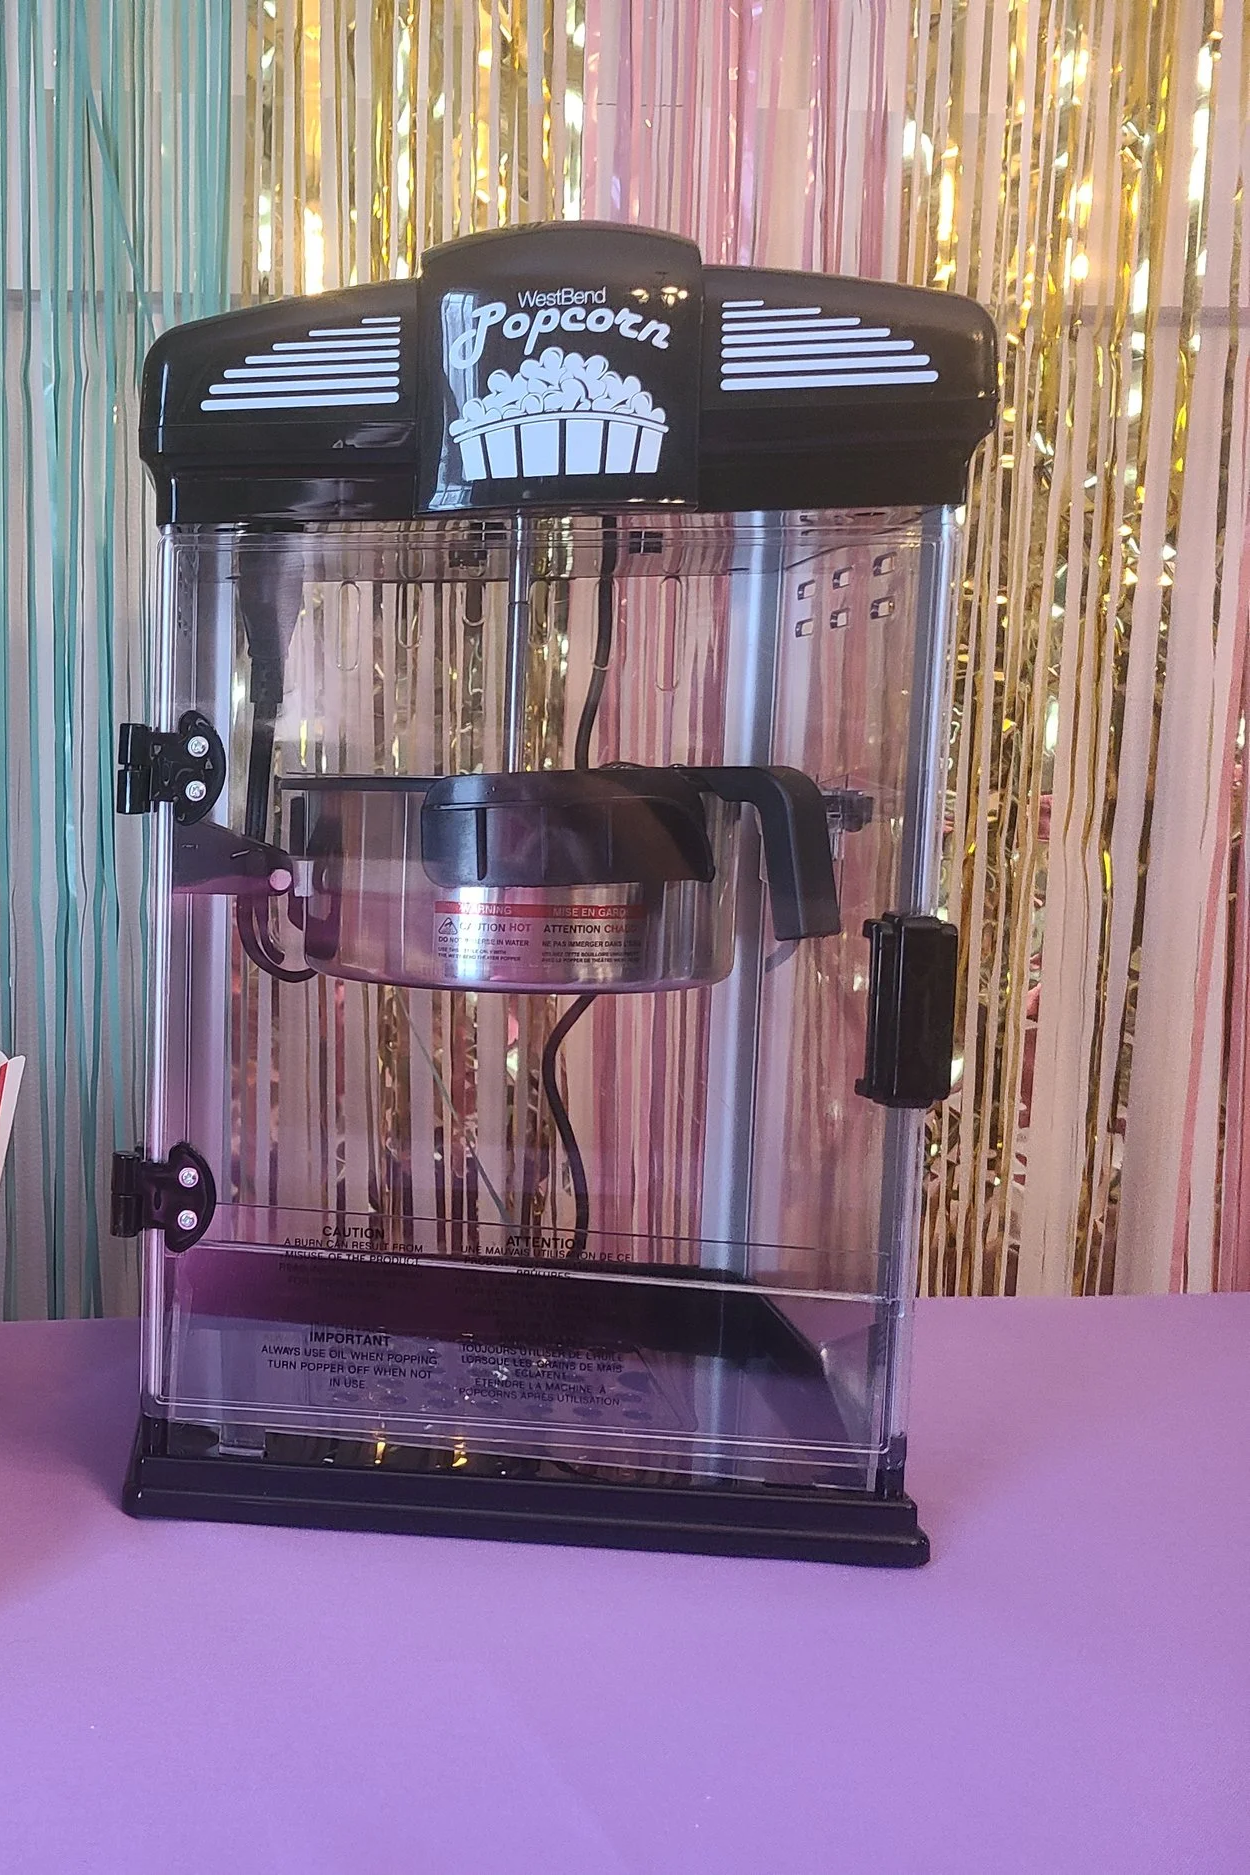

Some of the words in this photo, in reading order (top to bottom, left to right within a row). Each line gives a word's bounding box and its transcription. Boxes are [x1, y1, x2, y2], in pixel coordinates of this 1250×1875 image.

[517, 286, 607, 308] WestBend
[450, 302, 671, 369] Popcorn
[461, 904, 512, 915] WRNING
[553, 908, 578, 917] MISE
[581, 908, 595, 917] EN
[598, 908, 630, 917] GARD
[509, 923, 532, 932] HOT
[543, 924, 601, 933] ATTENTION
[568, 940, 603, 948] IMMERGER
[322, 1226, 384, 1240] CAUTION
[284, 1237, 291, 1246] A
[294, 1238, 323, 1248] BURN
[326, 1239, 348, 1249] CAN
[351, 1241, 389, 1251] RESULT
[392, 1243, 423, 1253] FROM
[284, 1250, 323, 1260] MISUSE
[327, 1252, 343, 1261] OF
[346, 1253, 366, 1263] THE
[461, 1245, 482, 1255] UNE
[485, 1247, 530, 1257] MAUVAIS
[600, 1252, 613, 1261] DE
[616, 1252, 631, 1262] CE
[309, 1331, 391, 1347] IMPORTANT
[261, 1345, 301, 1357] ALWAYS
[304, 1348, 326, 1358] USE
[328, 1349, 347, 1359] OIL
[350, 1351, 384, 1362] WHEN
[461, 1343, 517, 1356] TOUJOURS
[520, 1346, 565, 1359] UTILISER
[569, 1350, 583, 1360] DE
[267, 1359, 297, 1370] TURN
[300, 1361, 344, 1373] POPPER
[348, 1365, 370, 1375] OFF
[373, 1367, 407, 1378] WHEN
[410, 1368, 433, 1380] NOT
[461, 1355, 510, 1367] LORSQUE
[513, 1358, 532, 1368] LES
[536, 1359, 576, 1371] GRAINS
[579, 1362, 593, 1372] DE
[329, 1378, 341, 1387] IN
[528, 1381, 542, 1390] LA
[545, 1382, 592, 1394] MACHINE
[458, 1387, 517, 1399] POPCORNS
